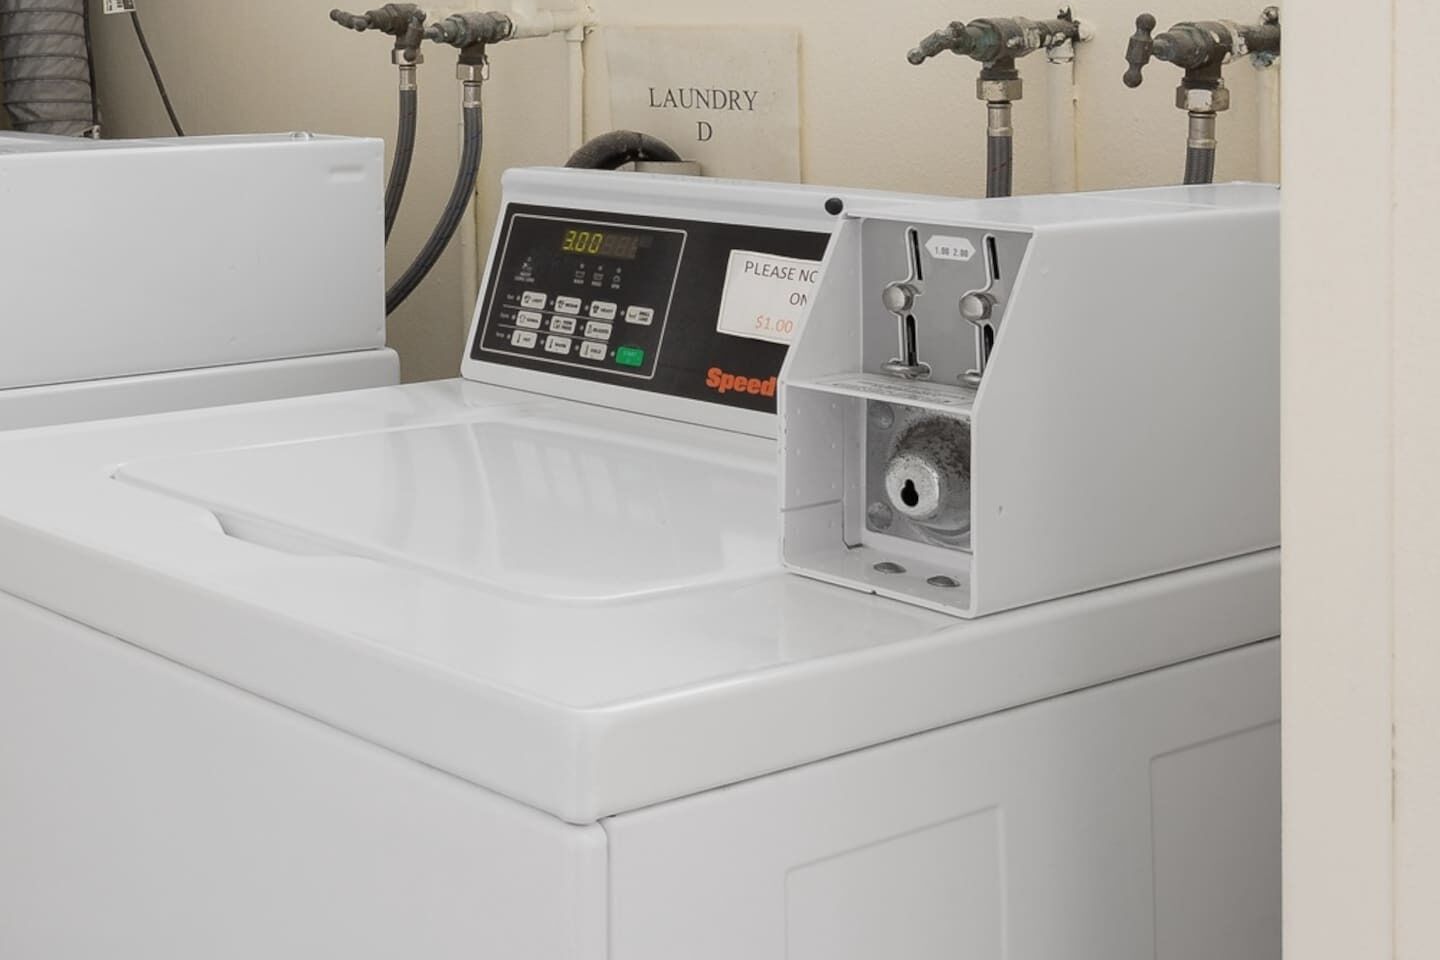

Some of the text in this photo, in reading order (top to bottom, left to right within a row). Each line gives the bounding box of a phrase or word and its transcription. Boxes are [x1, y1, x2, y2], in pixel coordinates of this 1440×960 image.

[648, 87, 759, 111] LAUNDRY
[697, 121, 713, 141] D
[563, 230, 603, 253] 3.00
[744, 260, 796, 281] PLEASE
[755, 314, 794, 334] $1.00
[705, 367, 778, 397] Speed
